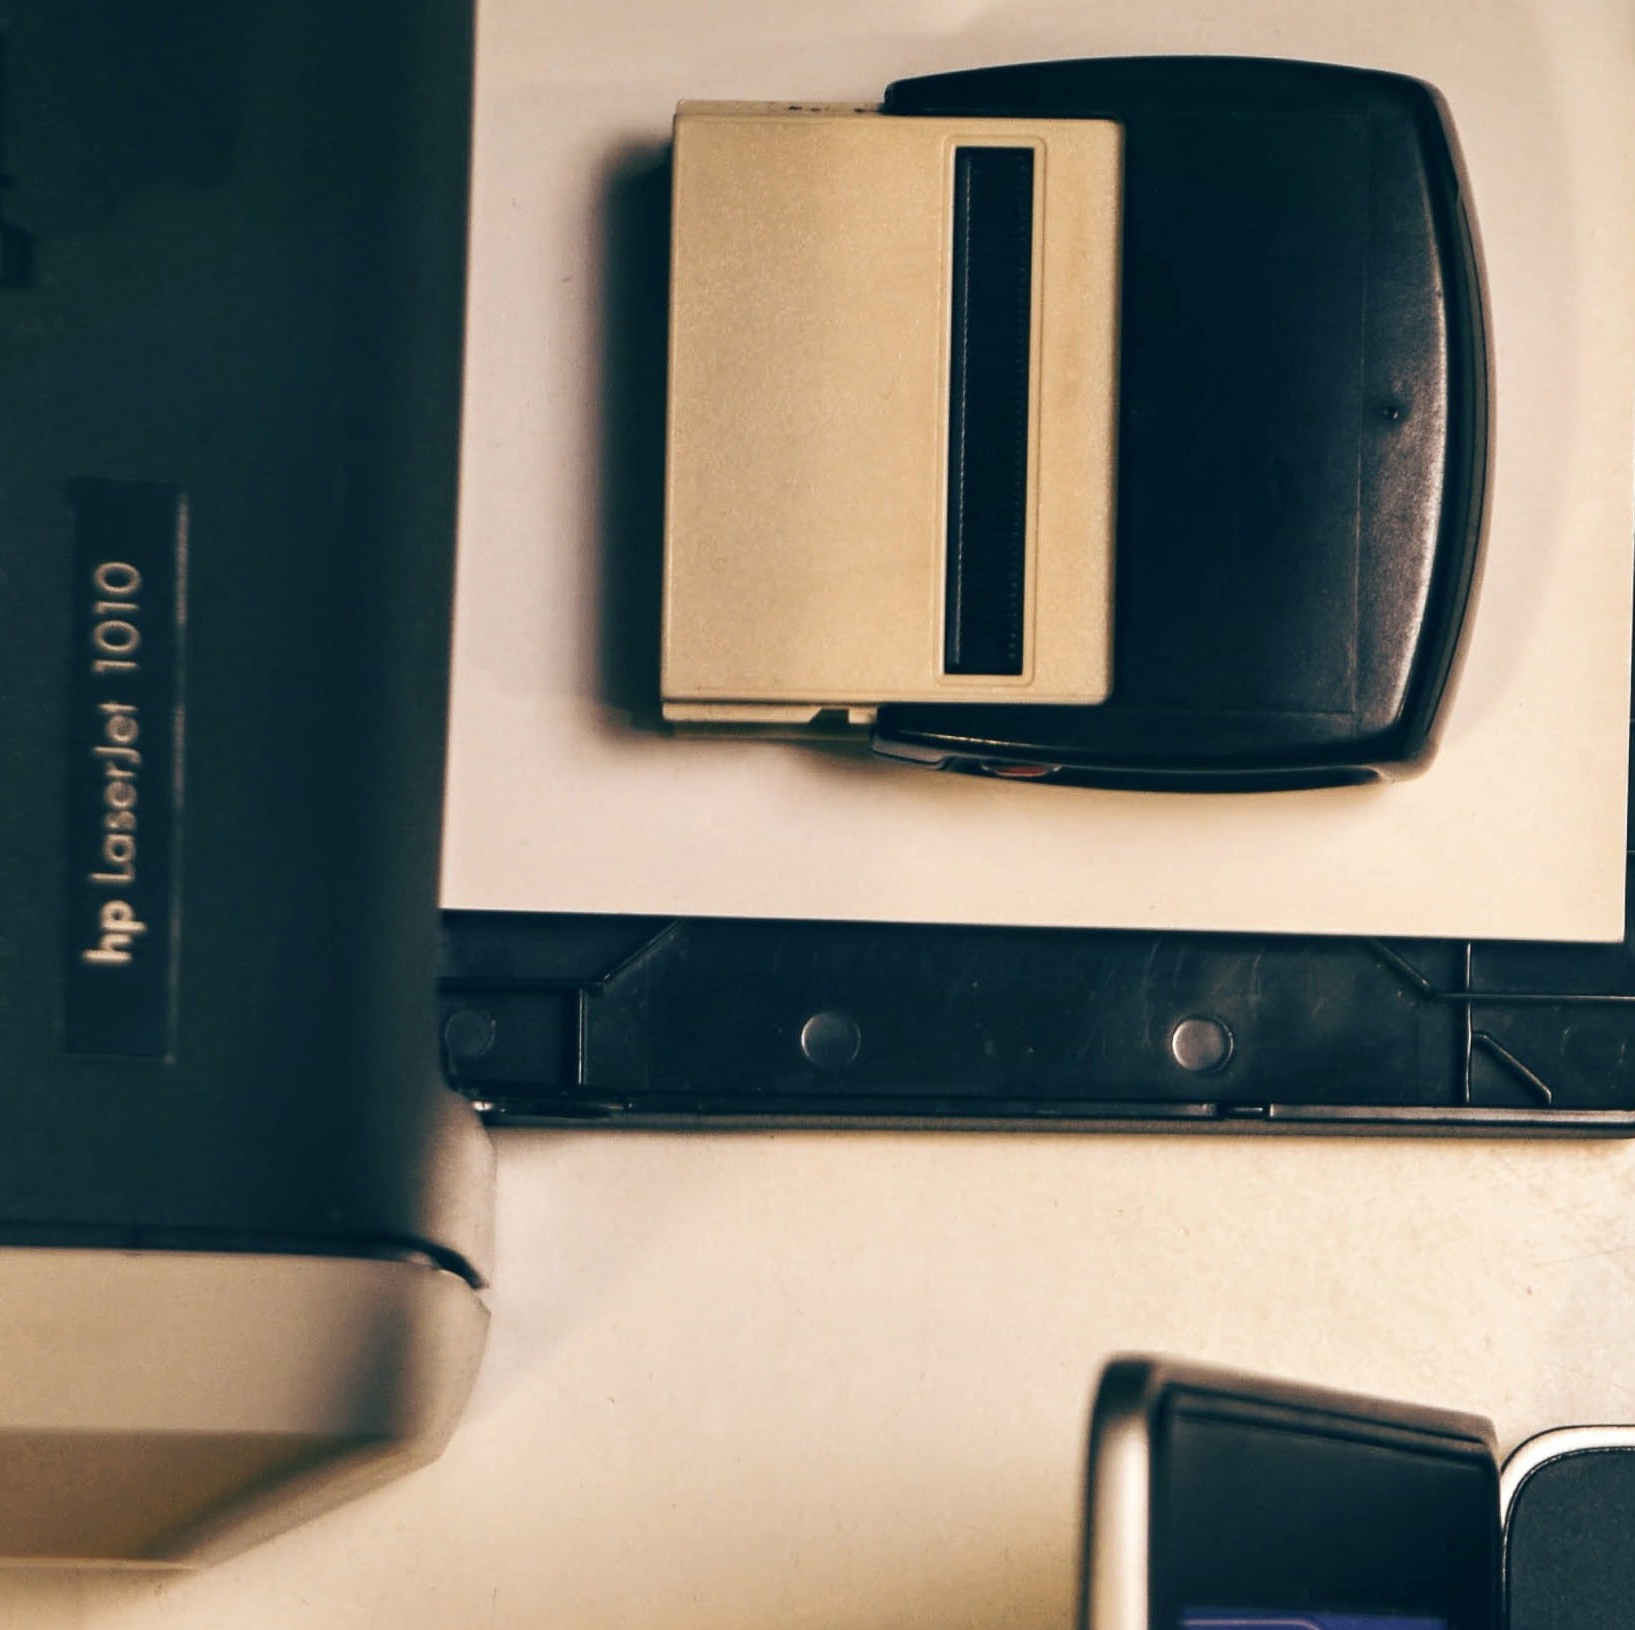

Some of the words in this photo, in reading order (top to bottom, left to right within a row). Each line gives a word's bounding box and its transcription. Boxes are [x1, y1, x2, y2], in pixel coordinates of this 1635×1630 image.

[93, 561, 140, 674] 1010
[89, 701, 141, 884] LaserJet
[83, 900, 146, 964] hp
